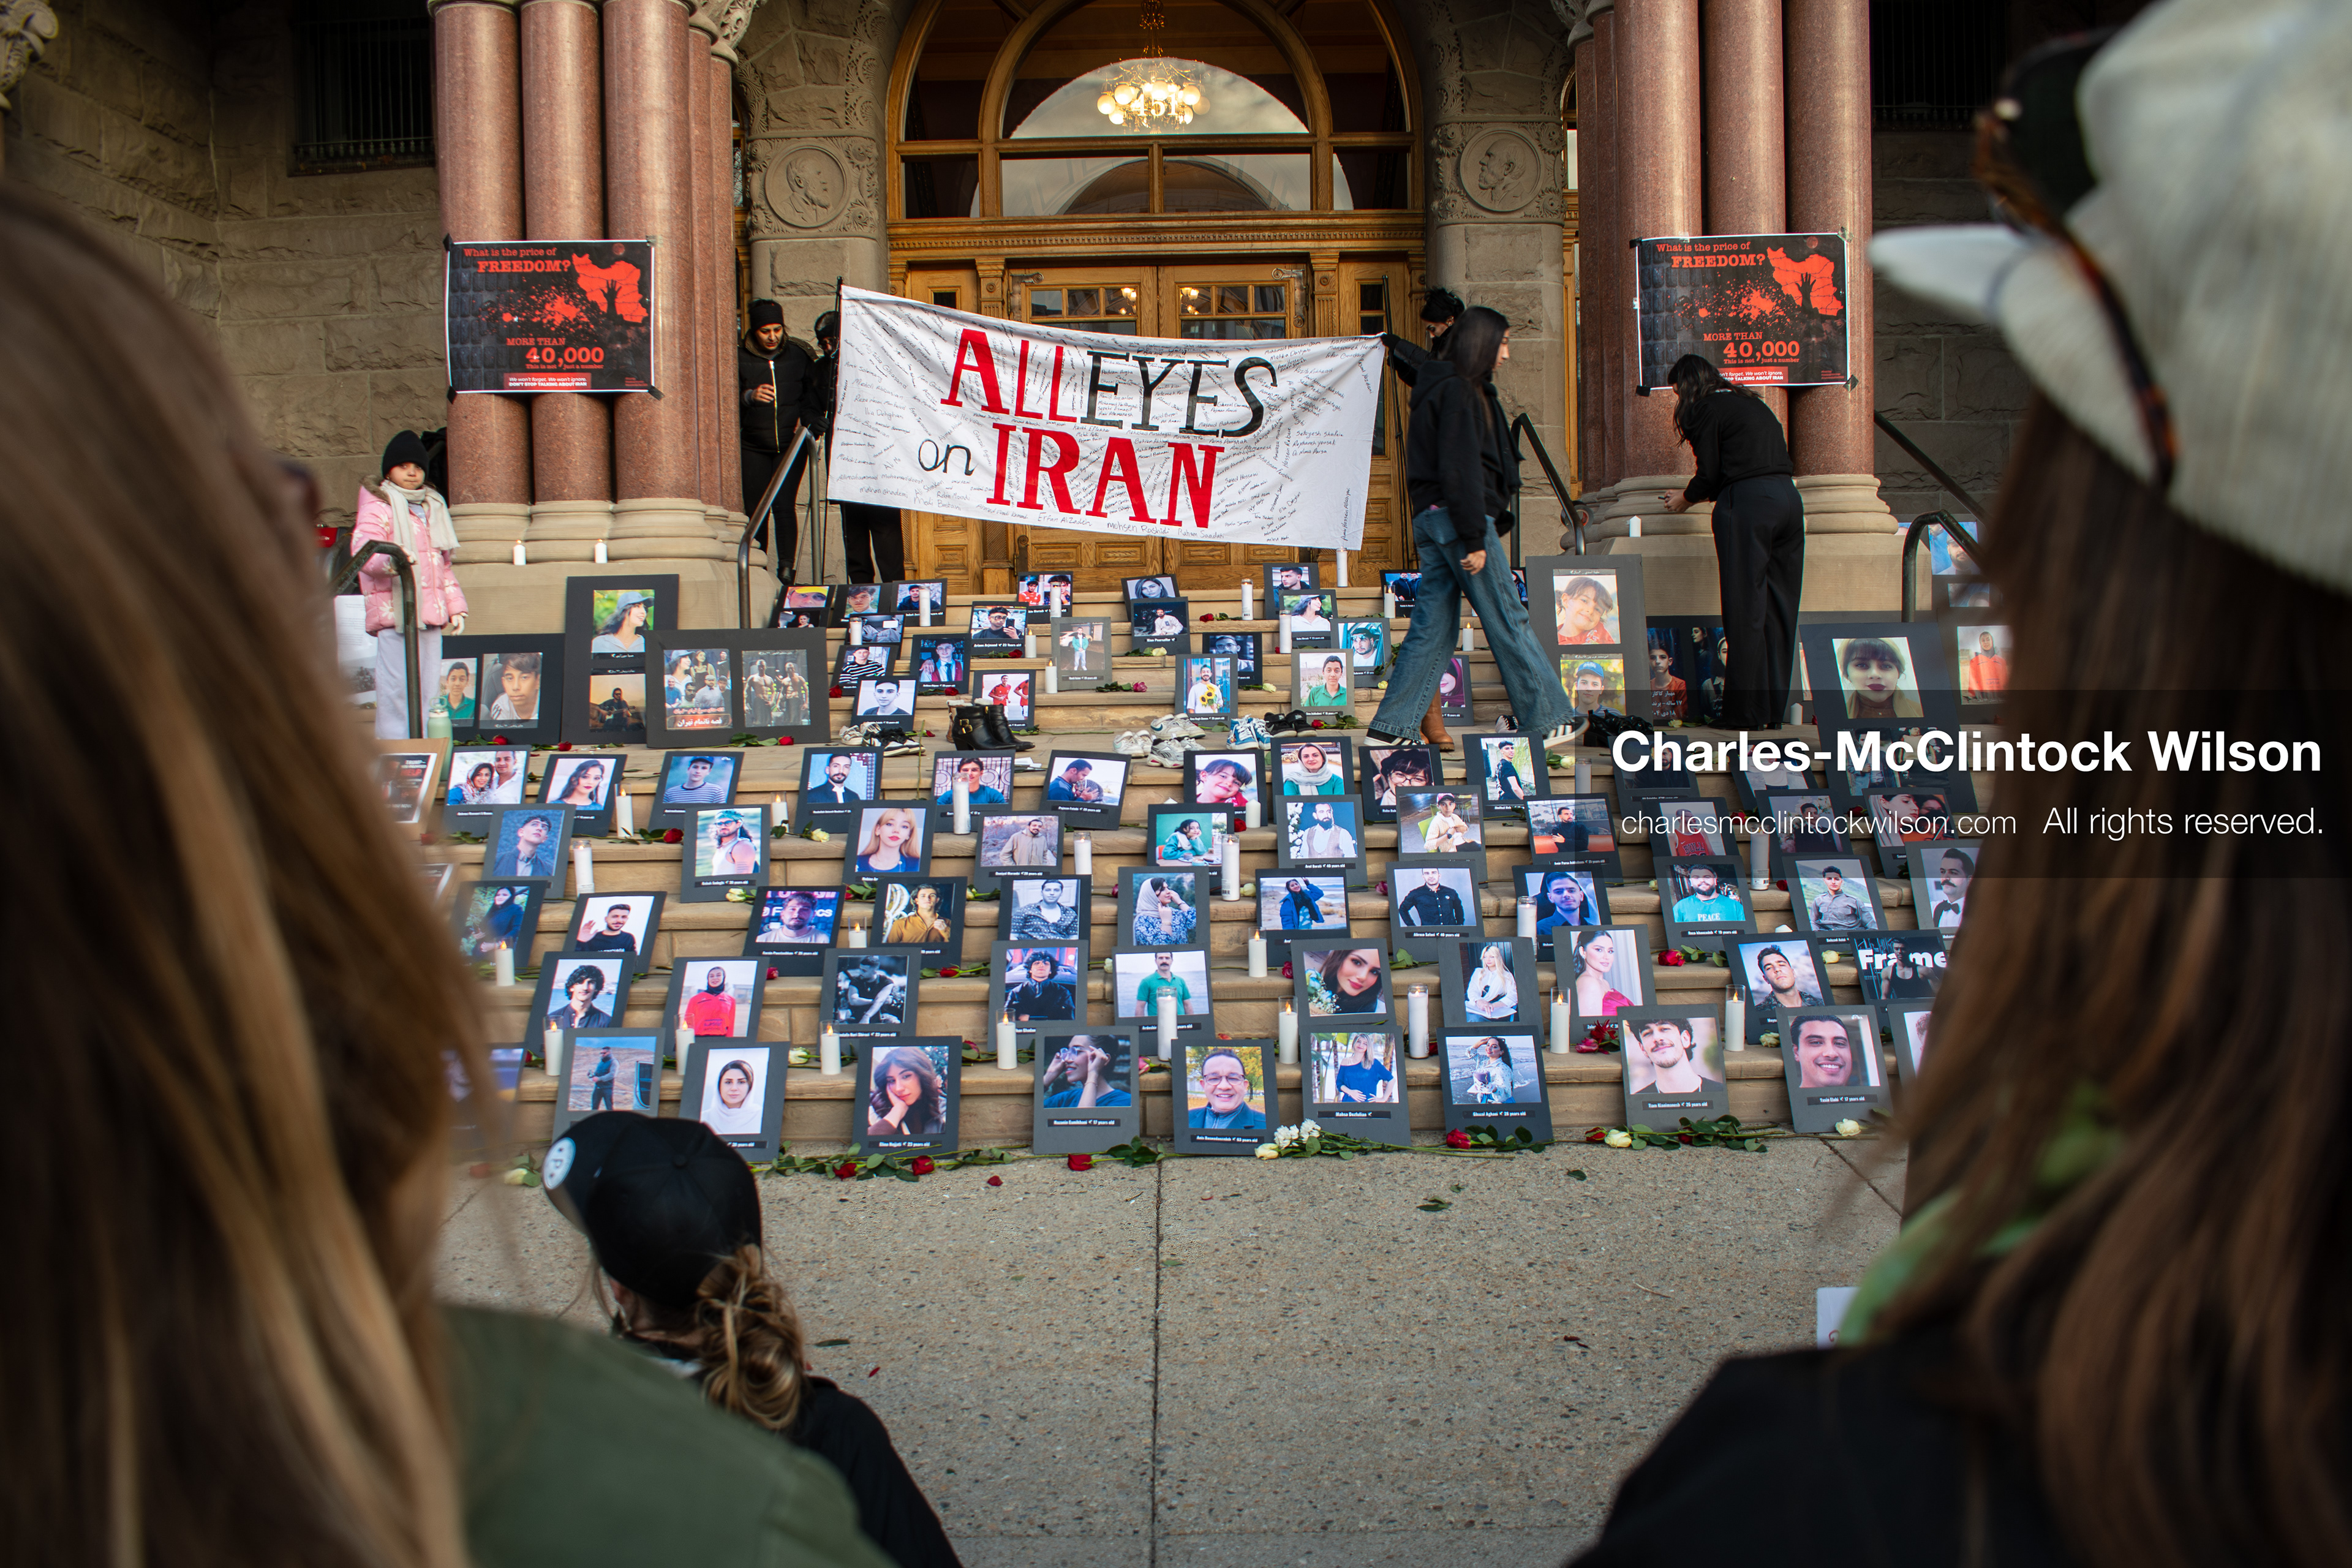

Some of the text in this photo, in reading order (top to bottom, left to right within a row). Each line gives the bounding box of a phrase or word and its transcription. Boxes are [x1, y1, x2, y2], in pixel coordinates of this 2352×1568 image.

[463, 248, 490, 257] What
[491, 248, 500, 257] is
[518, 247, 544, 257] price
[545, 247, 557, 256] of
[1656, 243, 1682, 252] What
[1694, 243, 1710, 251] the
[1713, 243, 1738, 252] price
[1740, 241, 1751, 250] of
[477, 260, 571, 273] FREEDOM?
[1671, 254, 1766, 268] FREEDOM?
[506, 337, 566, 345] MORE THAN
[1733, 332, 1763, 341] THAN
[1723, 341, 1800, 361] 40,000
[526, 347, 605, 368] 40,000
[919, 439, 979, 476] on
[987, 423, 1225, 529] IRAN
[1698, 913, 1721, 921] PEACE
